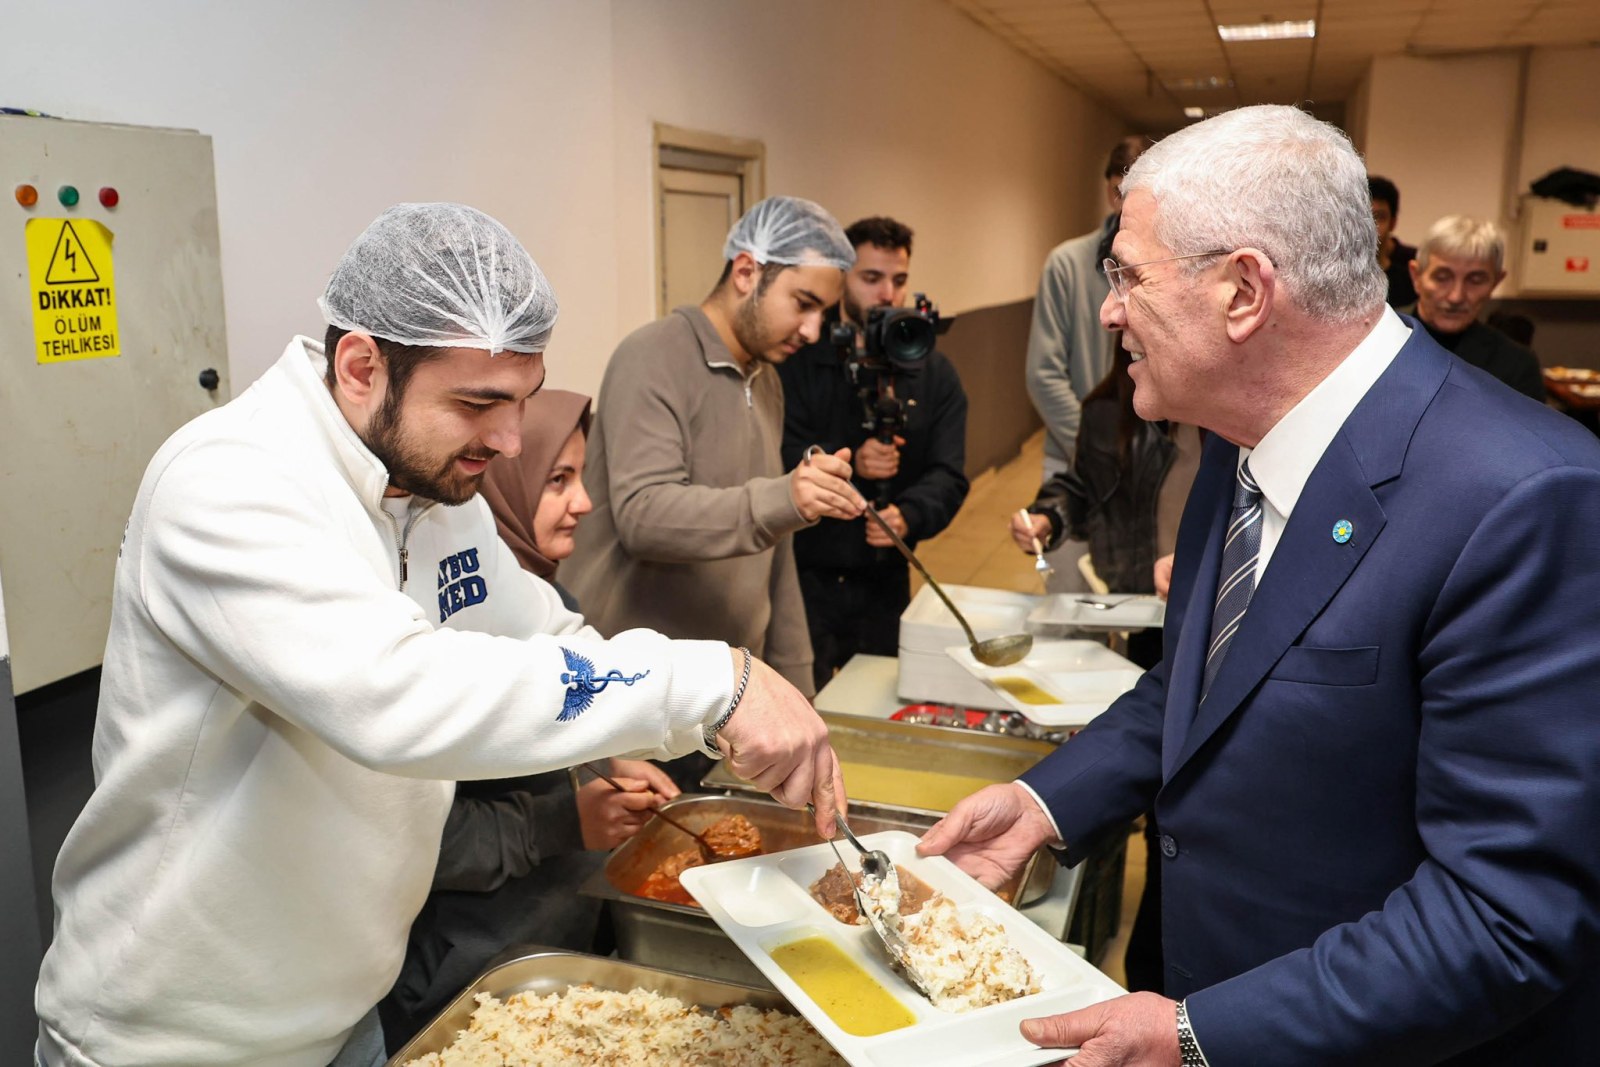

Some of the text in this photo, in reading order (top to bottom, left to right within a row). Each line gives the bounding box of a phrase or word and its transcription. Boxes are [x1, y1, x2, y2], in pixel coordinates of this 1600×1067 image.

[55, 313, 102, 335] ÖLÜM
[42, 330, 115, 357] TEHLİKESİ
[437, 574, 488, 624] MED
